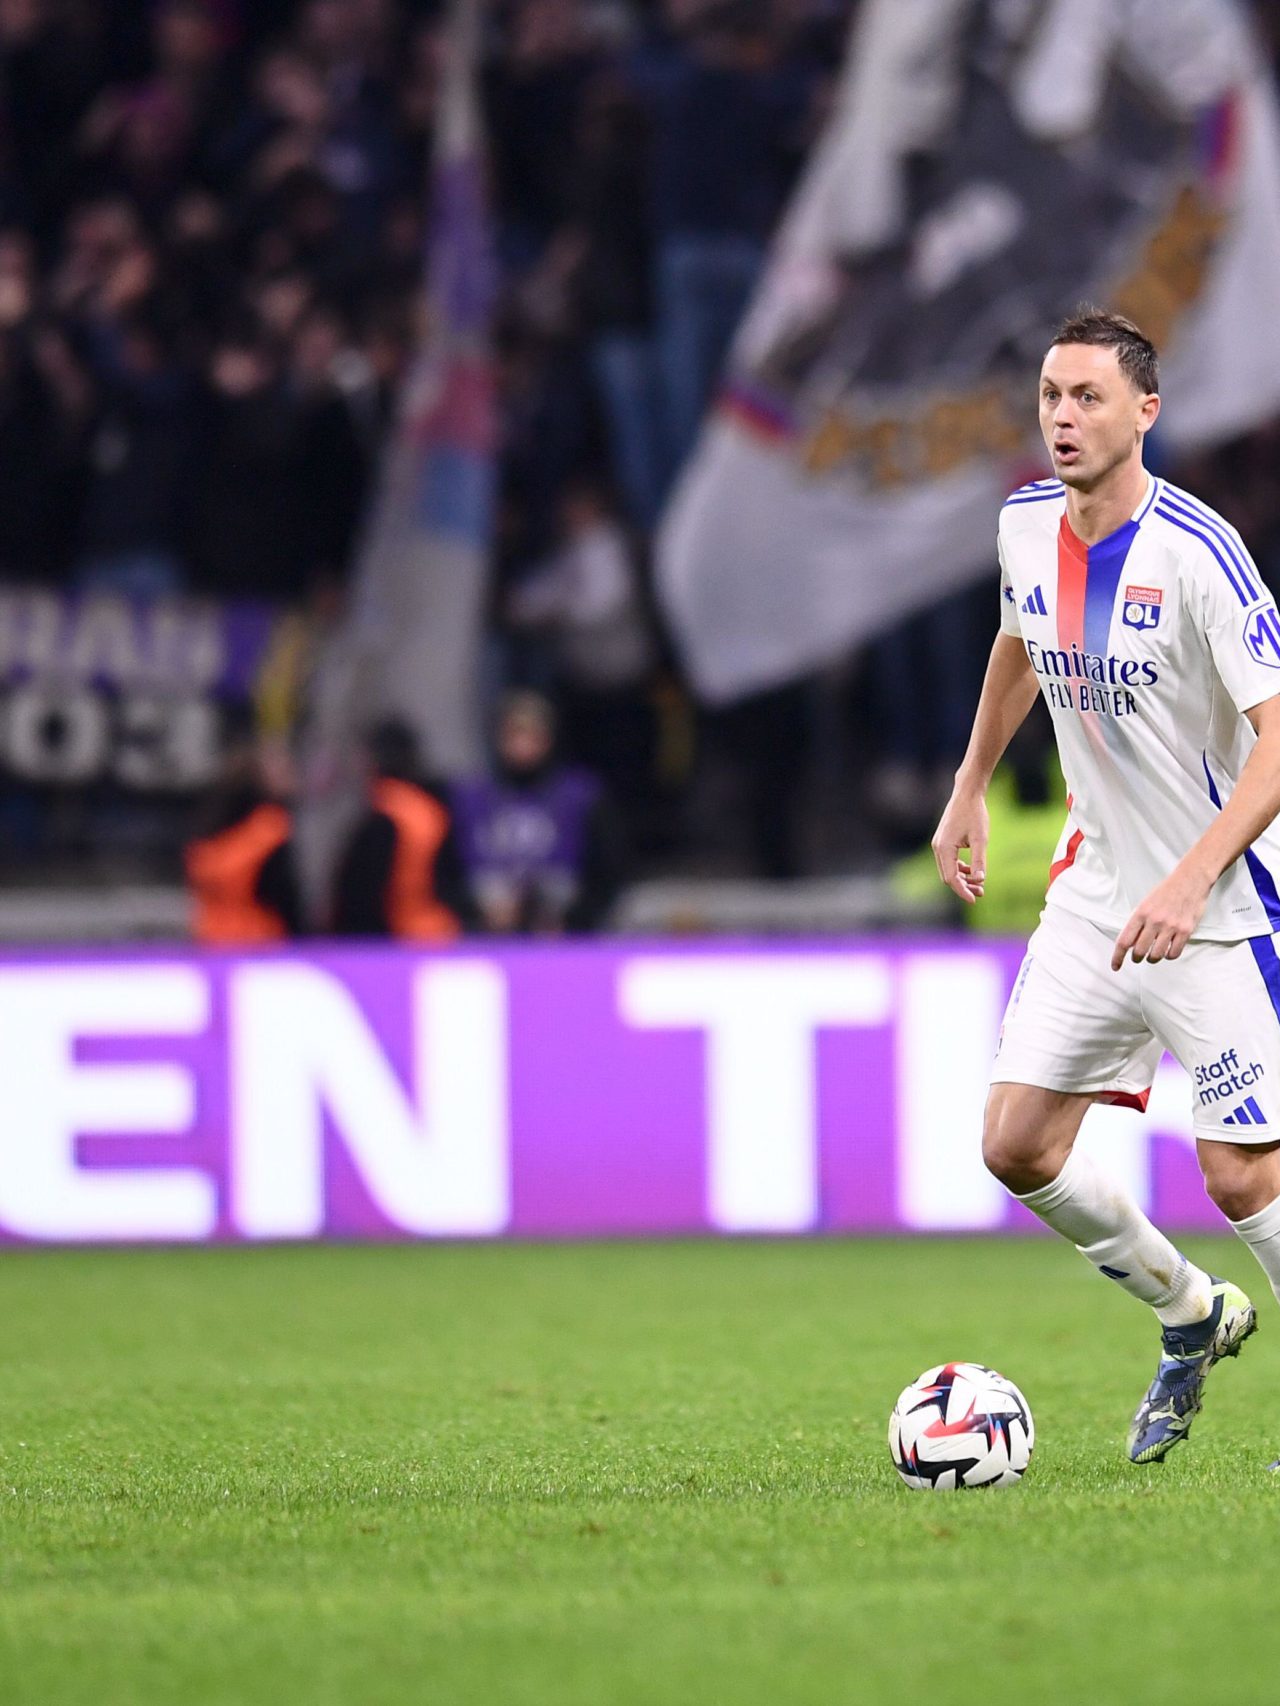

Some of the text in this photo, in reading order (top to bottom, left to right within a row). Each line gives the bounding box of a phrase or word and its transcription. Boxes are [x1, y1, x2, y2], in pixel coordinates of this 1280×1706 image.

[1126, 604, 1156, 626] OL
[1027, 640, 1159, 687] Emirates
[1050, 683, 1138, 717] FLY BETTER
[1195, 1048, 1239, 1086] Staff
[1199, 1062, 1265, 1106] match
[0, 960, 508, 1240] EN
